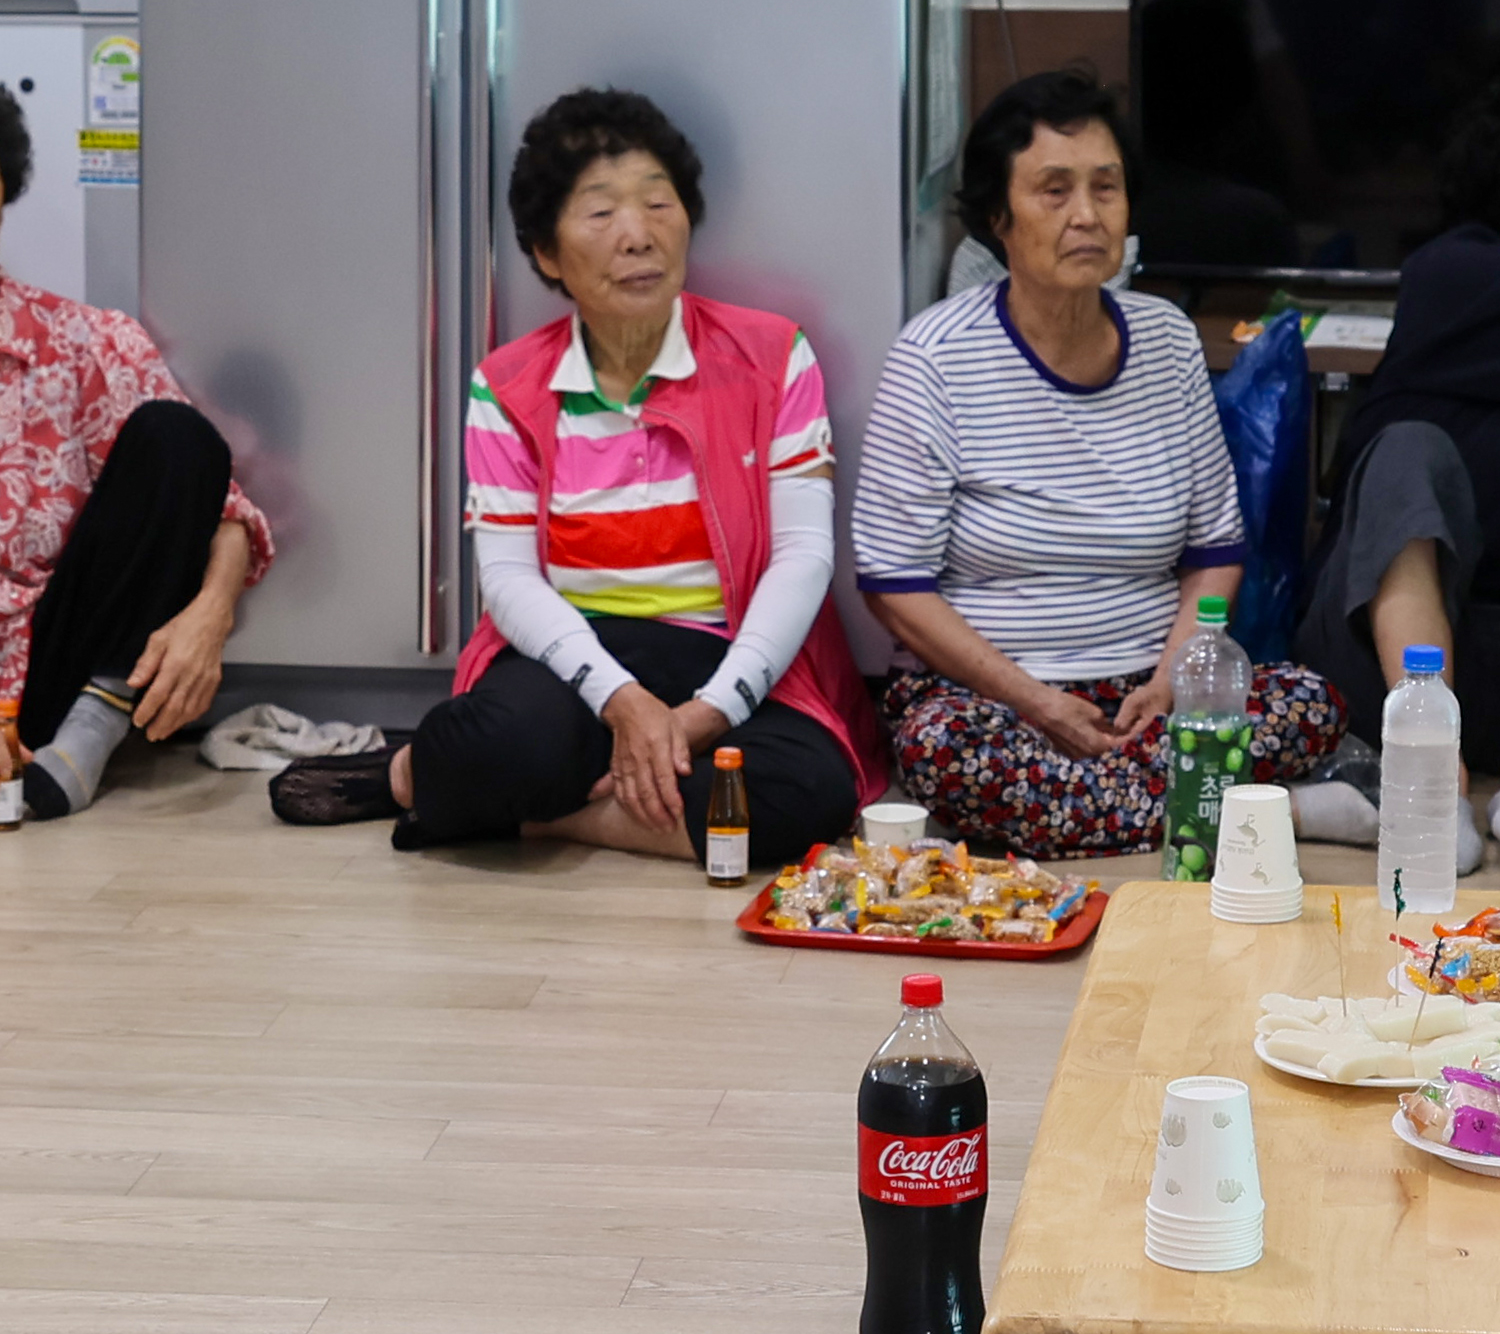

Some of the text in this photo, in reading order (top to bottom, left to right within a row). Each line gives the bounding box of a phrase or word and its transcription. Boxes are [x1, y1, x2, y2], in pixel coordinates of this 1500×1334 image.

[1198, 801, 1223, 825] 매
[878, 1133, 982, 1181] Coca-Cola
[890, 1176, 971, 1189] ORIGINAL TASTE
